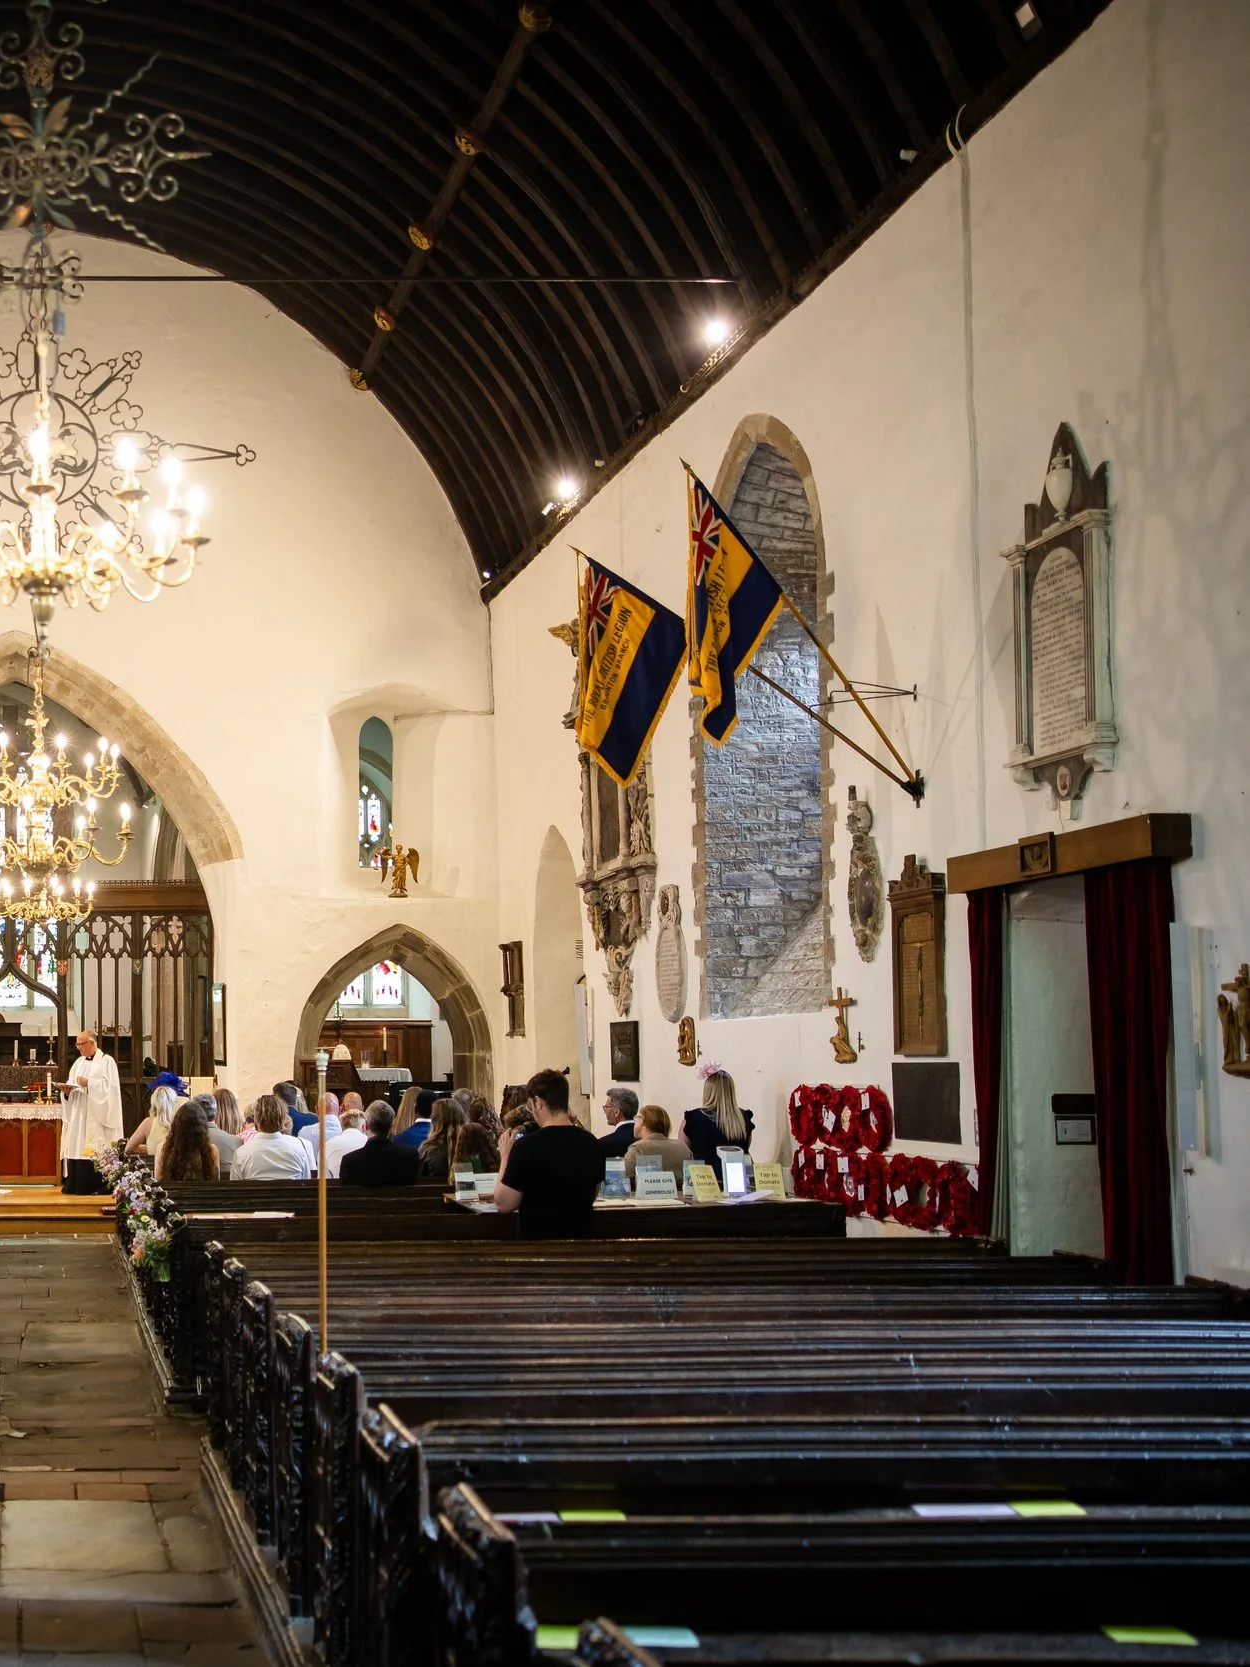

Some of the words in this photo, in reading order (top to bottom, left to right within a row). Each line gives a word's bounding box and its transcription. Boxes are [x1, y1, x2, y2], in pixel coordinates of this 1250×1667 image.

[599, 644, 618, 679] BRITISH
[613, 606, 633, 644] LEGION
[616, 638, 631, 669] BRANCH
